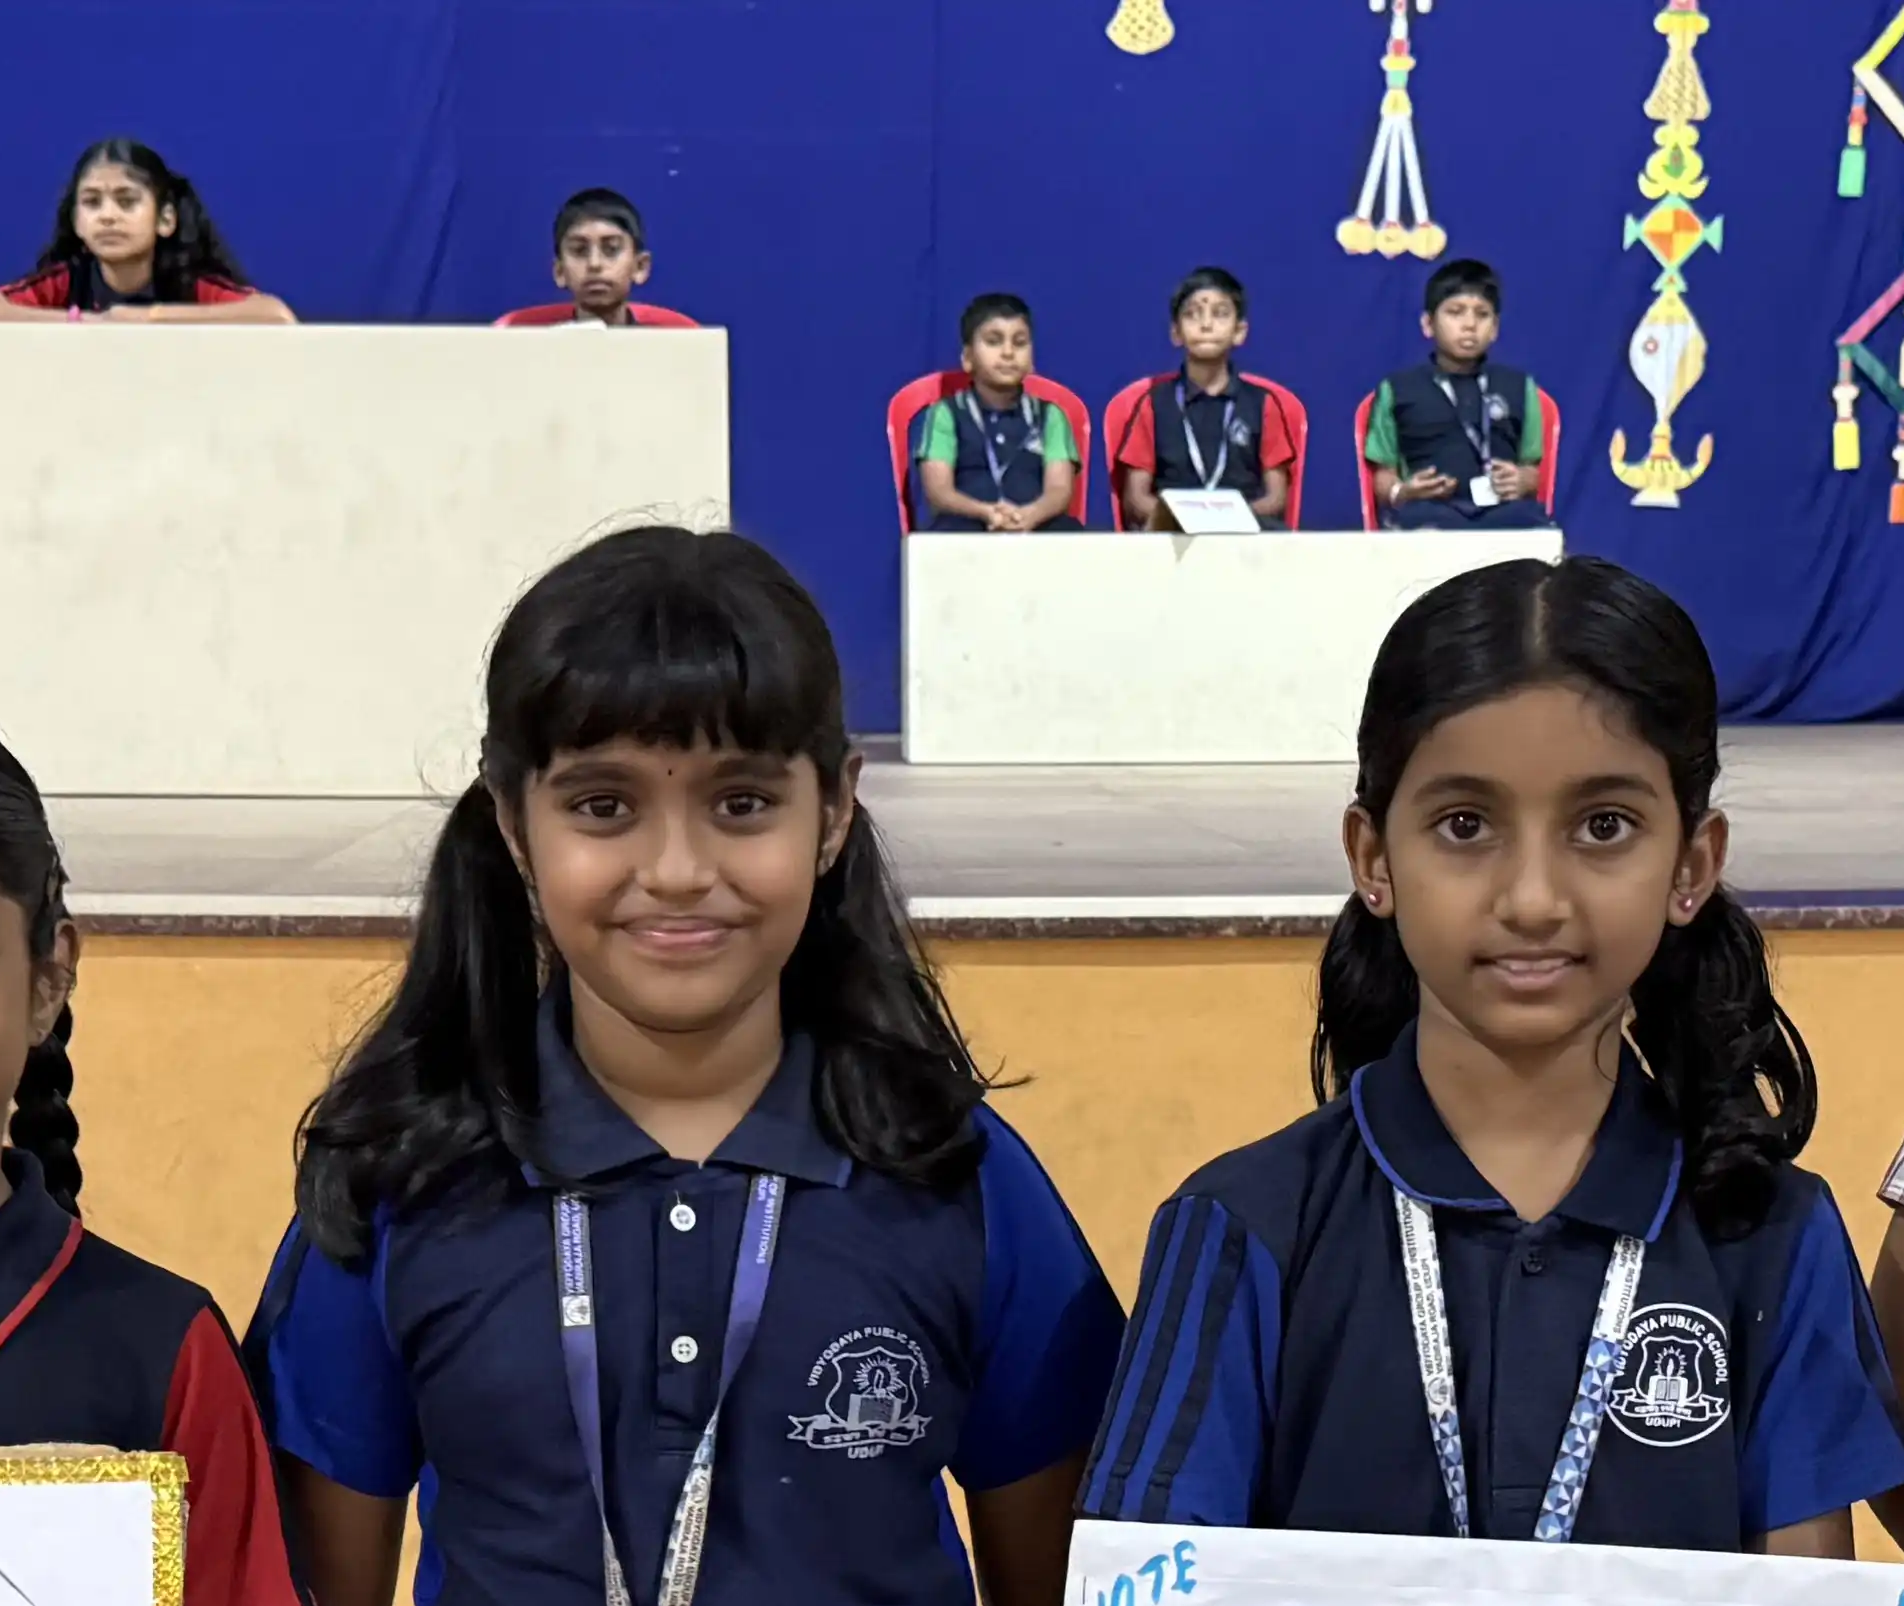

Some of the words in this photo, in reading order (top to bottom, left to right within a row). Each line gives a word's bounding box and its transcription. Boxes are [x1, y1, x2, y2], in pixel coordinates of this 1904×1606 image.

[754, 1196, 777, 1265] INSTITUTIONS
[1418, 1257, 1432, 1289] UDUPI
[1410, 1281, 1426, 1319] GROUP
[1423, 1290, 1439, 1322] ROAD,
[1612, 1266, 1636, 1334] INSTITUTIONS
[807, 1330, 862, 1387] VIDYODAYA
[864, 1327, 908, 1344] PUBLIC
[1426, 1324, 1445, 1374] VADIRAJA
[1659, 1314, 1705, 1337] PUBLIC
[1703, 1332, 1728, 1385] SCHOOL
[1645, 1416, 1681, 1428] UDUPI
